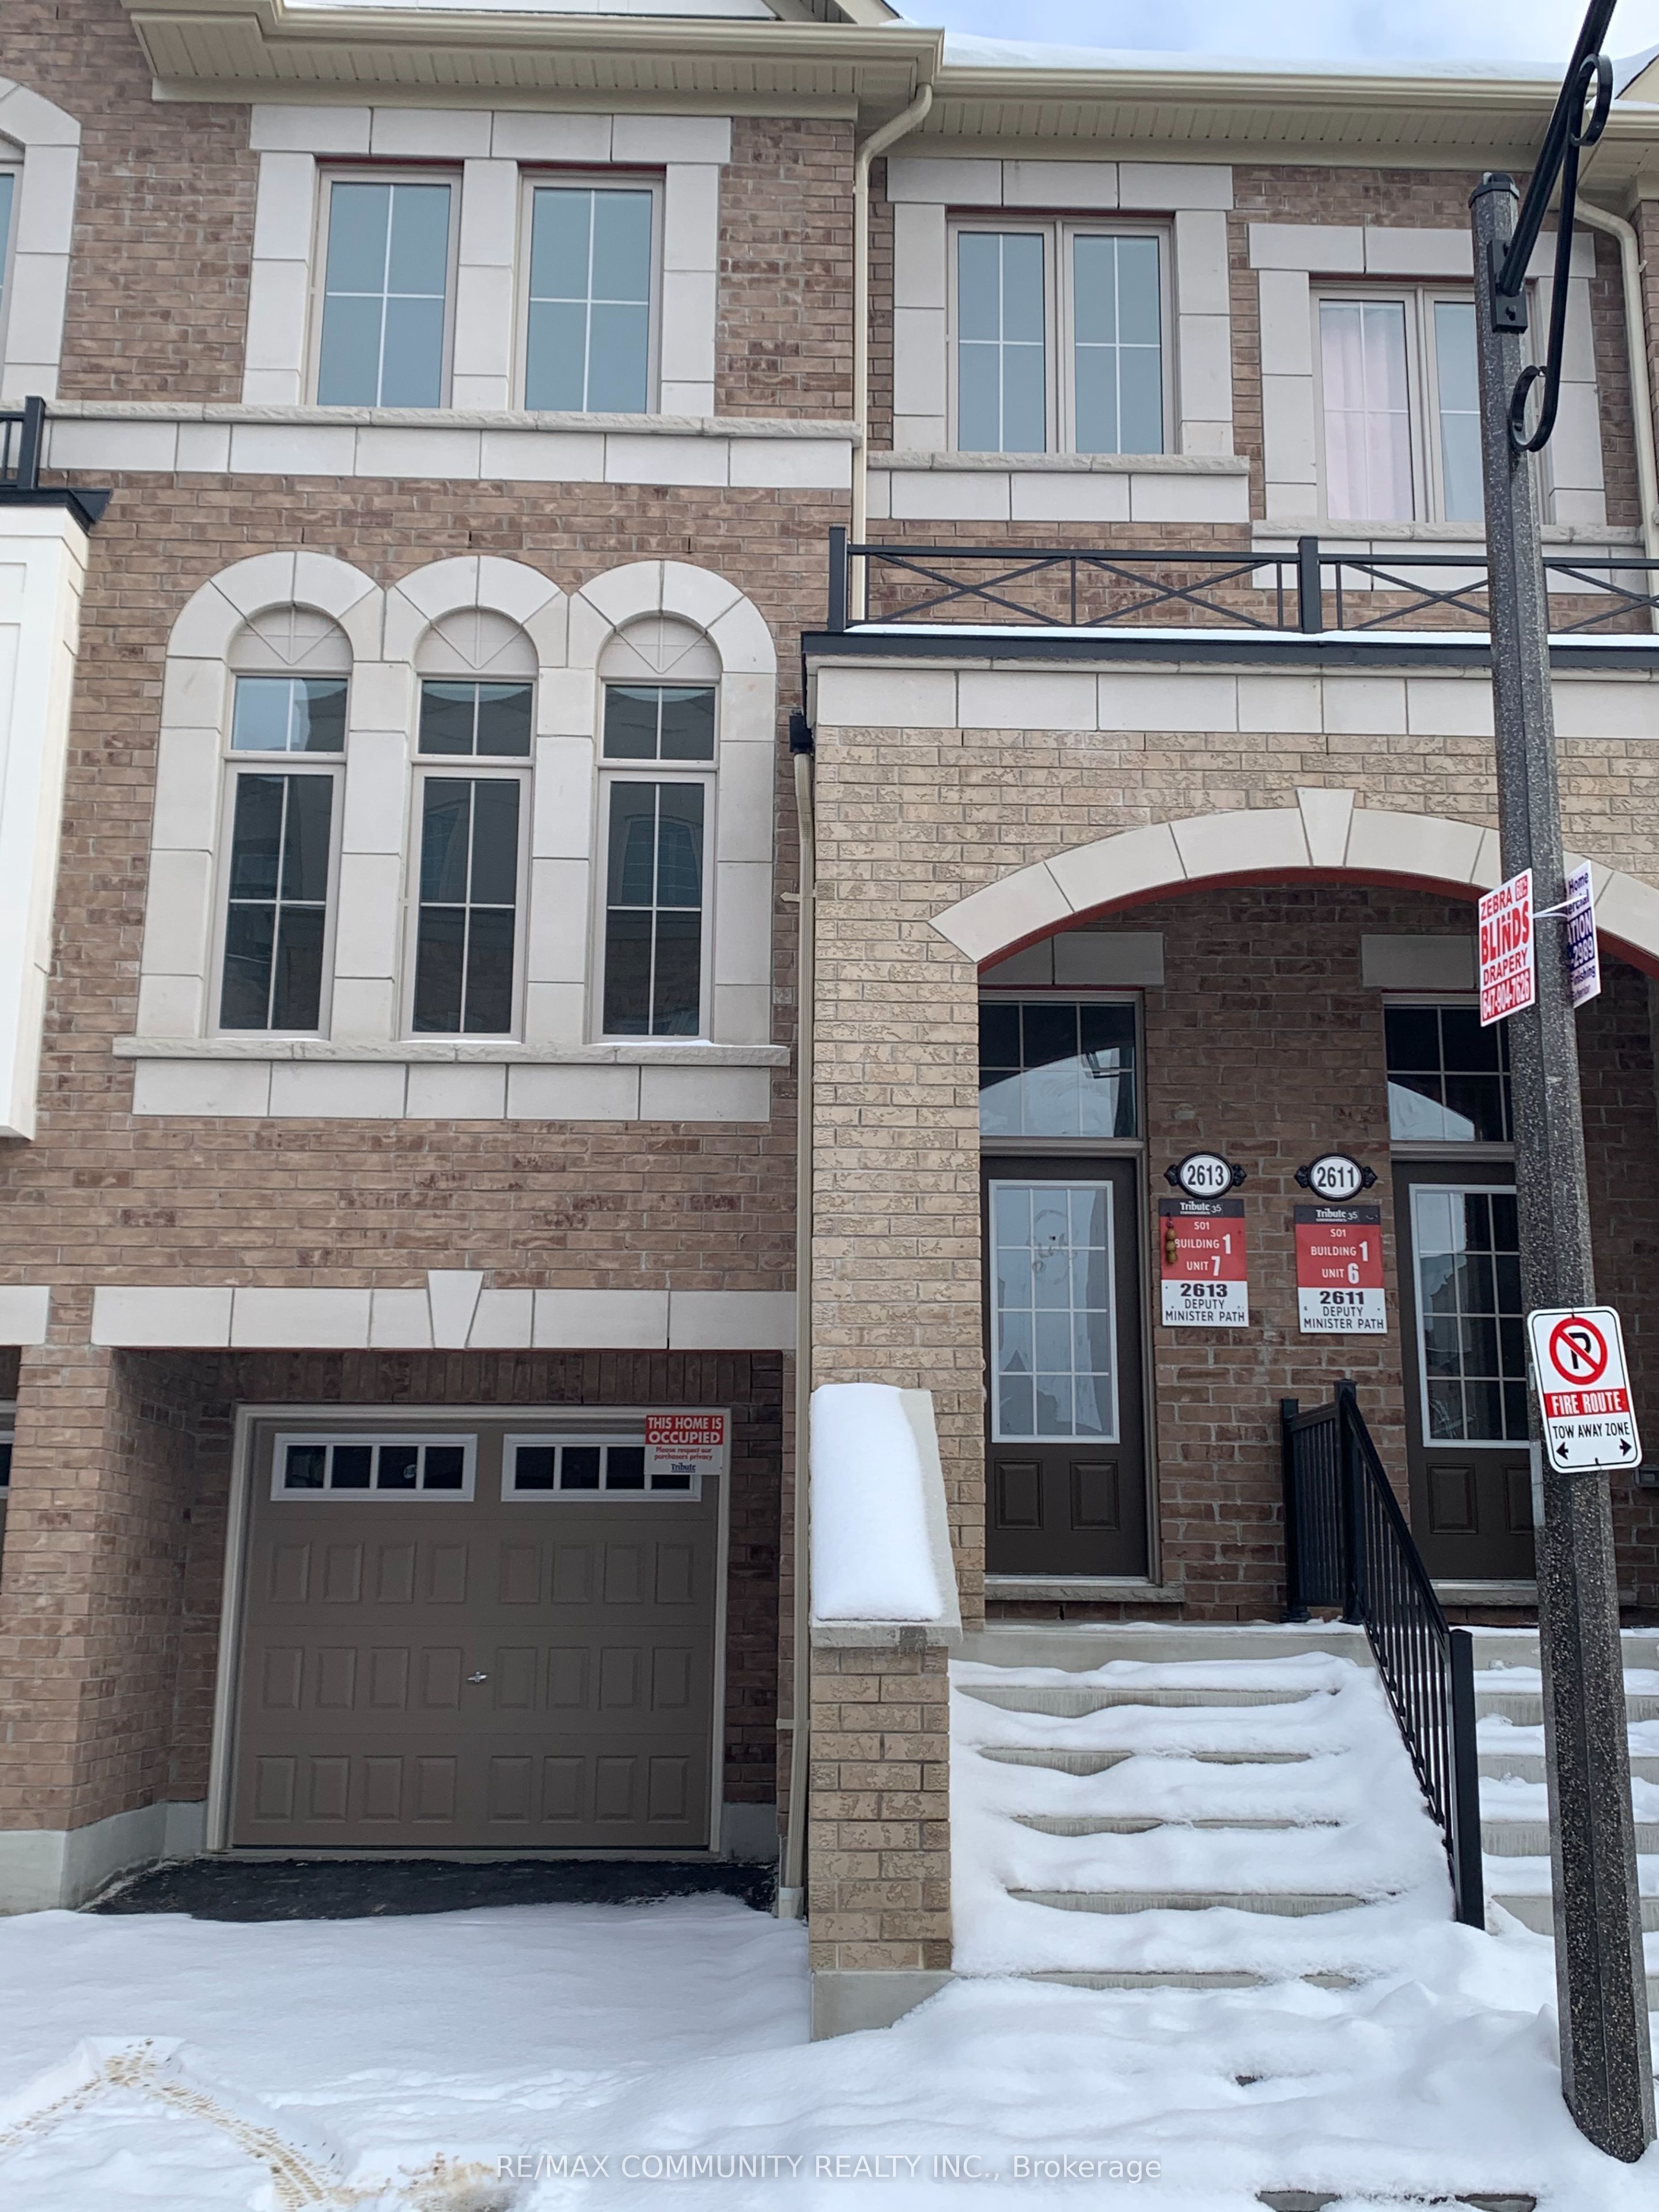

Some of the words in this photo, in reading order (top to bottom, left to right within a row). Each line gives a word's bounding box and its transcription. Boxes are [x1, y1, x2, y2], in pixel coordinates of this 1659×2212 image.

[1569, 872, 1588, 895] Home
[1480, 886, 1513, 921] ZEBRA
[1481, 900, 1529, 966] BLINDS
[1483, 947, 1528, 986] DRAPERY
[1187, 1164, 1224, 1186] 2613
[1317, 1166, 1355, 1188] 2611
[1180, 1201, 1210, 1211] Tribute
[1316, 1208, 1347, 1218] Tribute
[1175, 1238, 1219, 1249] BUILDING
[1222, 1234, 1231, 1254] 1
[1310, 1246, 1357, 1256] BUILDING
[1359, 1241, 1368, 1262] 1
[1186, 1260, 1209, 1271] UNIT
[1211, 1256, 1221, 1277] 7
[1321, 1268, 1344, 1278] UNIT
[1347, 1263, 1359, 1284] 6
[1180, 1283, 1228, 1297] 2613
[1319, 1291, 1365, 1305] 2611
[1185, 1298, 1225, 1309] DEPUTY
[1323, 1306, 1363, 1317] DEPUTY
[1165, 1310, 1214, 1321] MINISTER
[1219, 1311, 1245, 1322] PATH
[1304, 1318, 1353, 1329] MINISTER
[1358, 1319, 1384, 1330] PATH
[1551, 1394, 1580, 1416] FIRE
[1581, 1391, 1622, 1414] ROUTE
[648, 1417, 672, 1429] THIS
[675, 1417, 709, 1429] HOME
[711, 1417, 722, 1430] IS
[1552, 1425, 1574, 1440] TOW
[1578, 1423, 1603, 1438] AWAY
[1605, 1422, 1631, 1436] ZONE
[649, 1431, 720, 1444] OCCUPIED
[671, 1463, 696, 1471] Tribute
